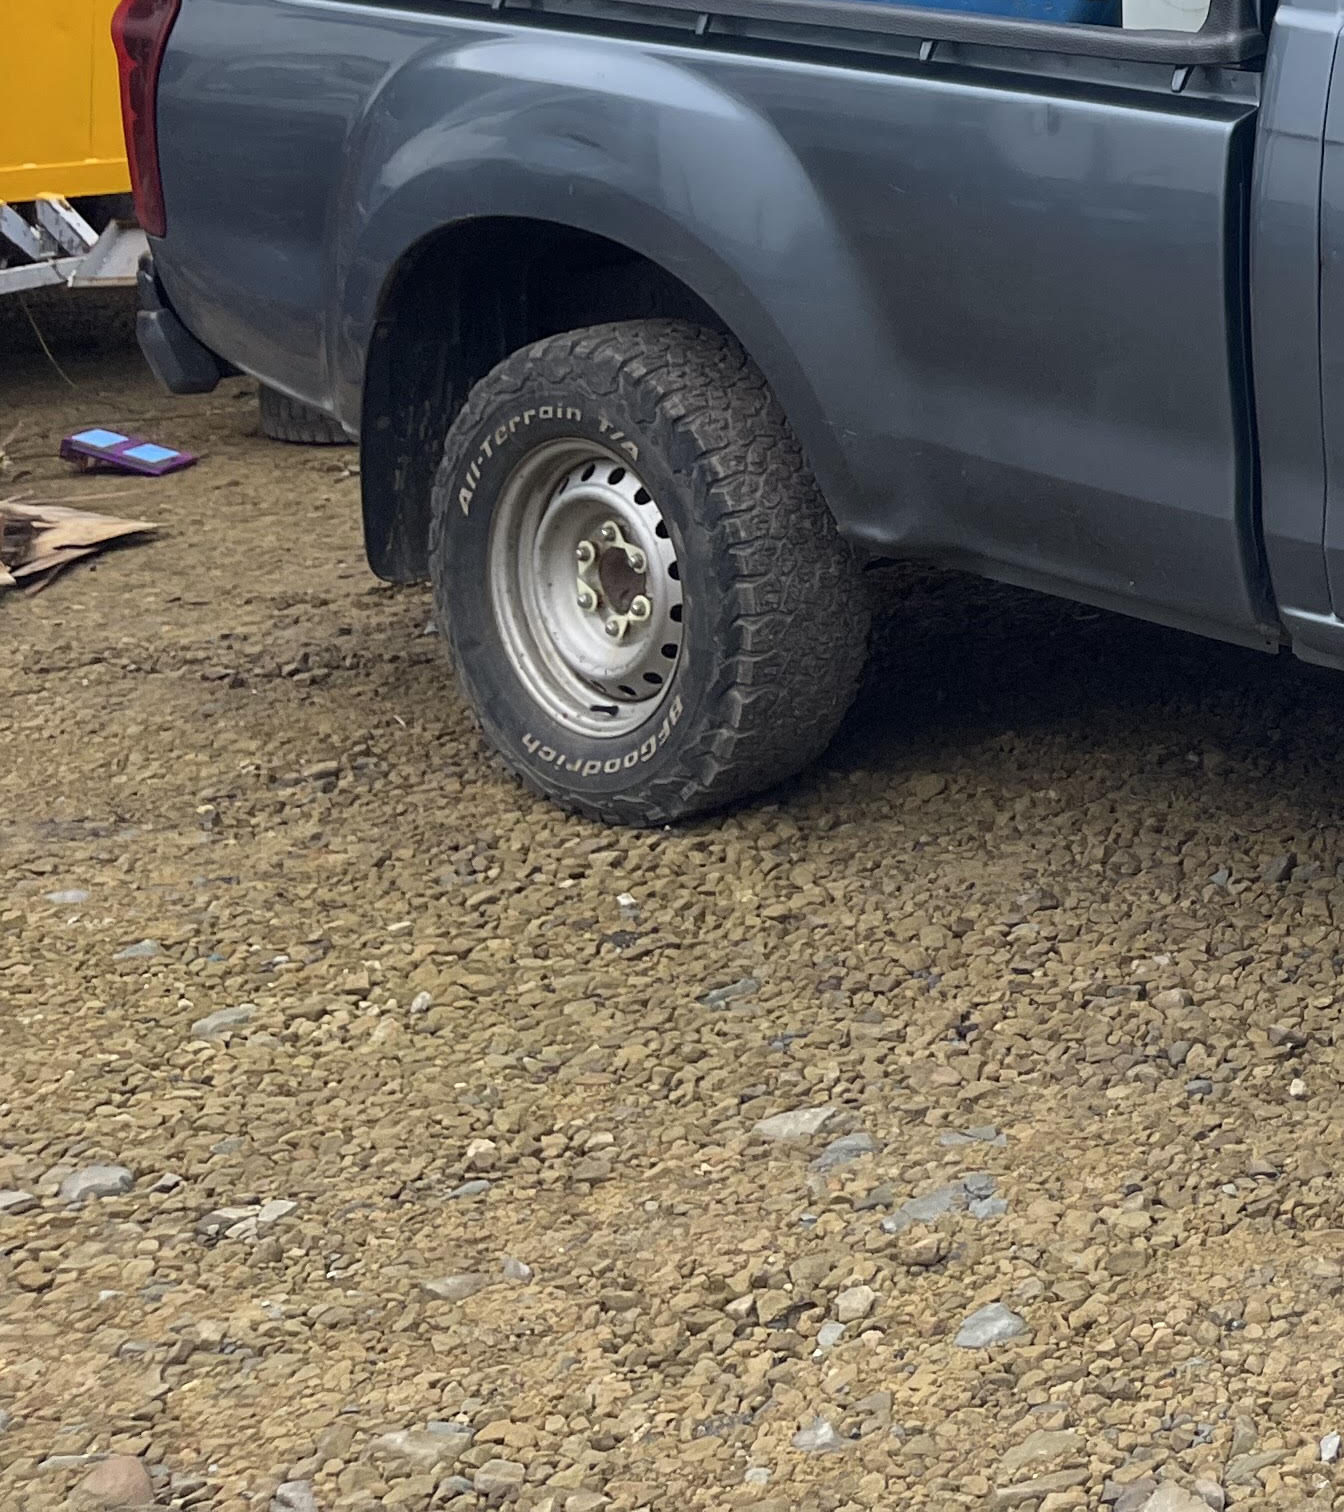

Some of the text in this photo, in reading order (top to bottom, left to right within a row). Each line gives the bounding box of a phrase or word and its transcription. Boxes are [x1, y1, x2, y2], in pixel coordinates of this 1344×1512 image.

[458, 401, 639, 517] All-Terrain T/A
[521, 695, 684, 777] BFGoodrich
